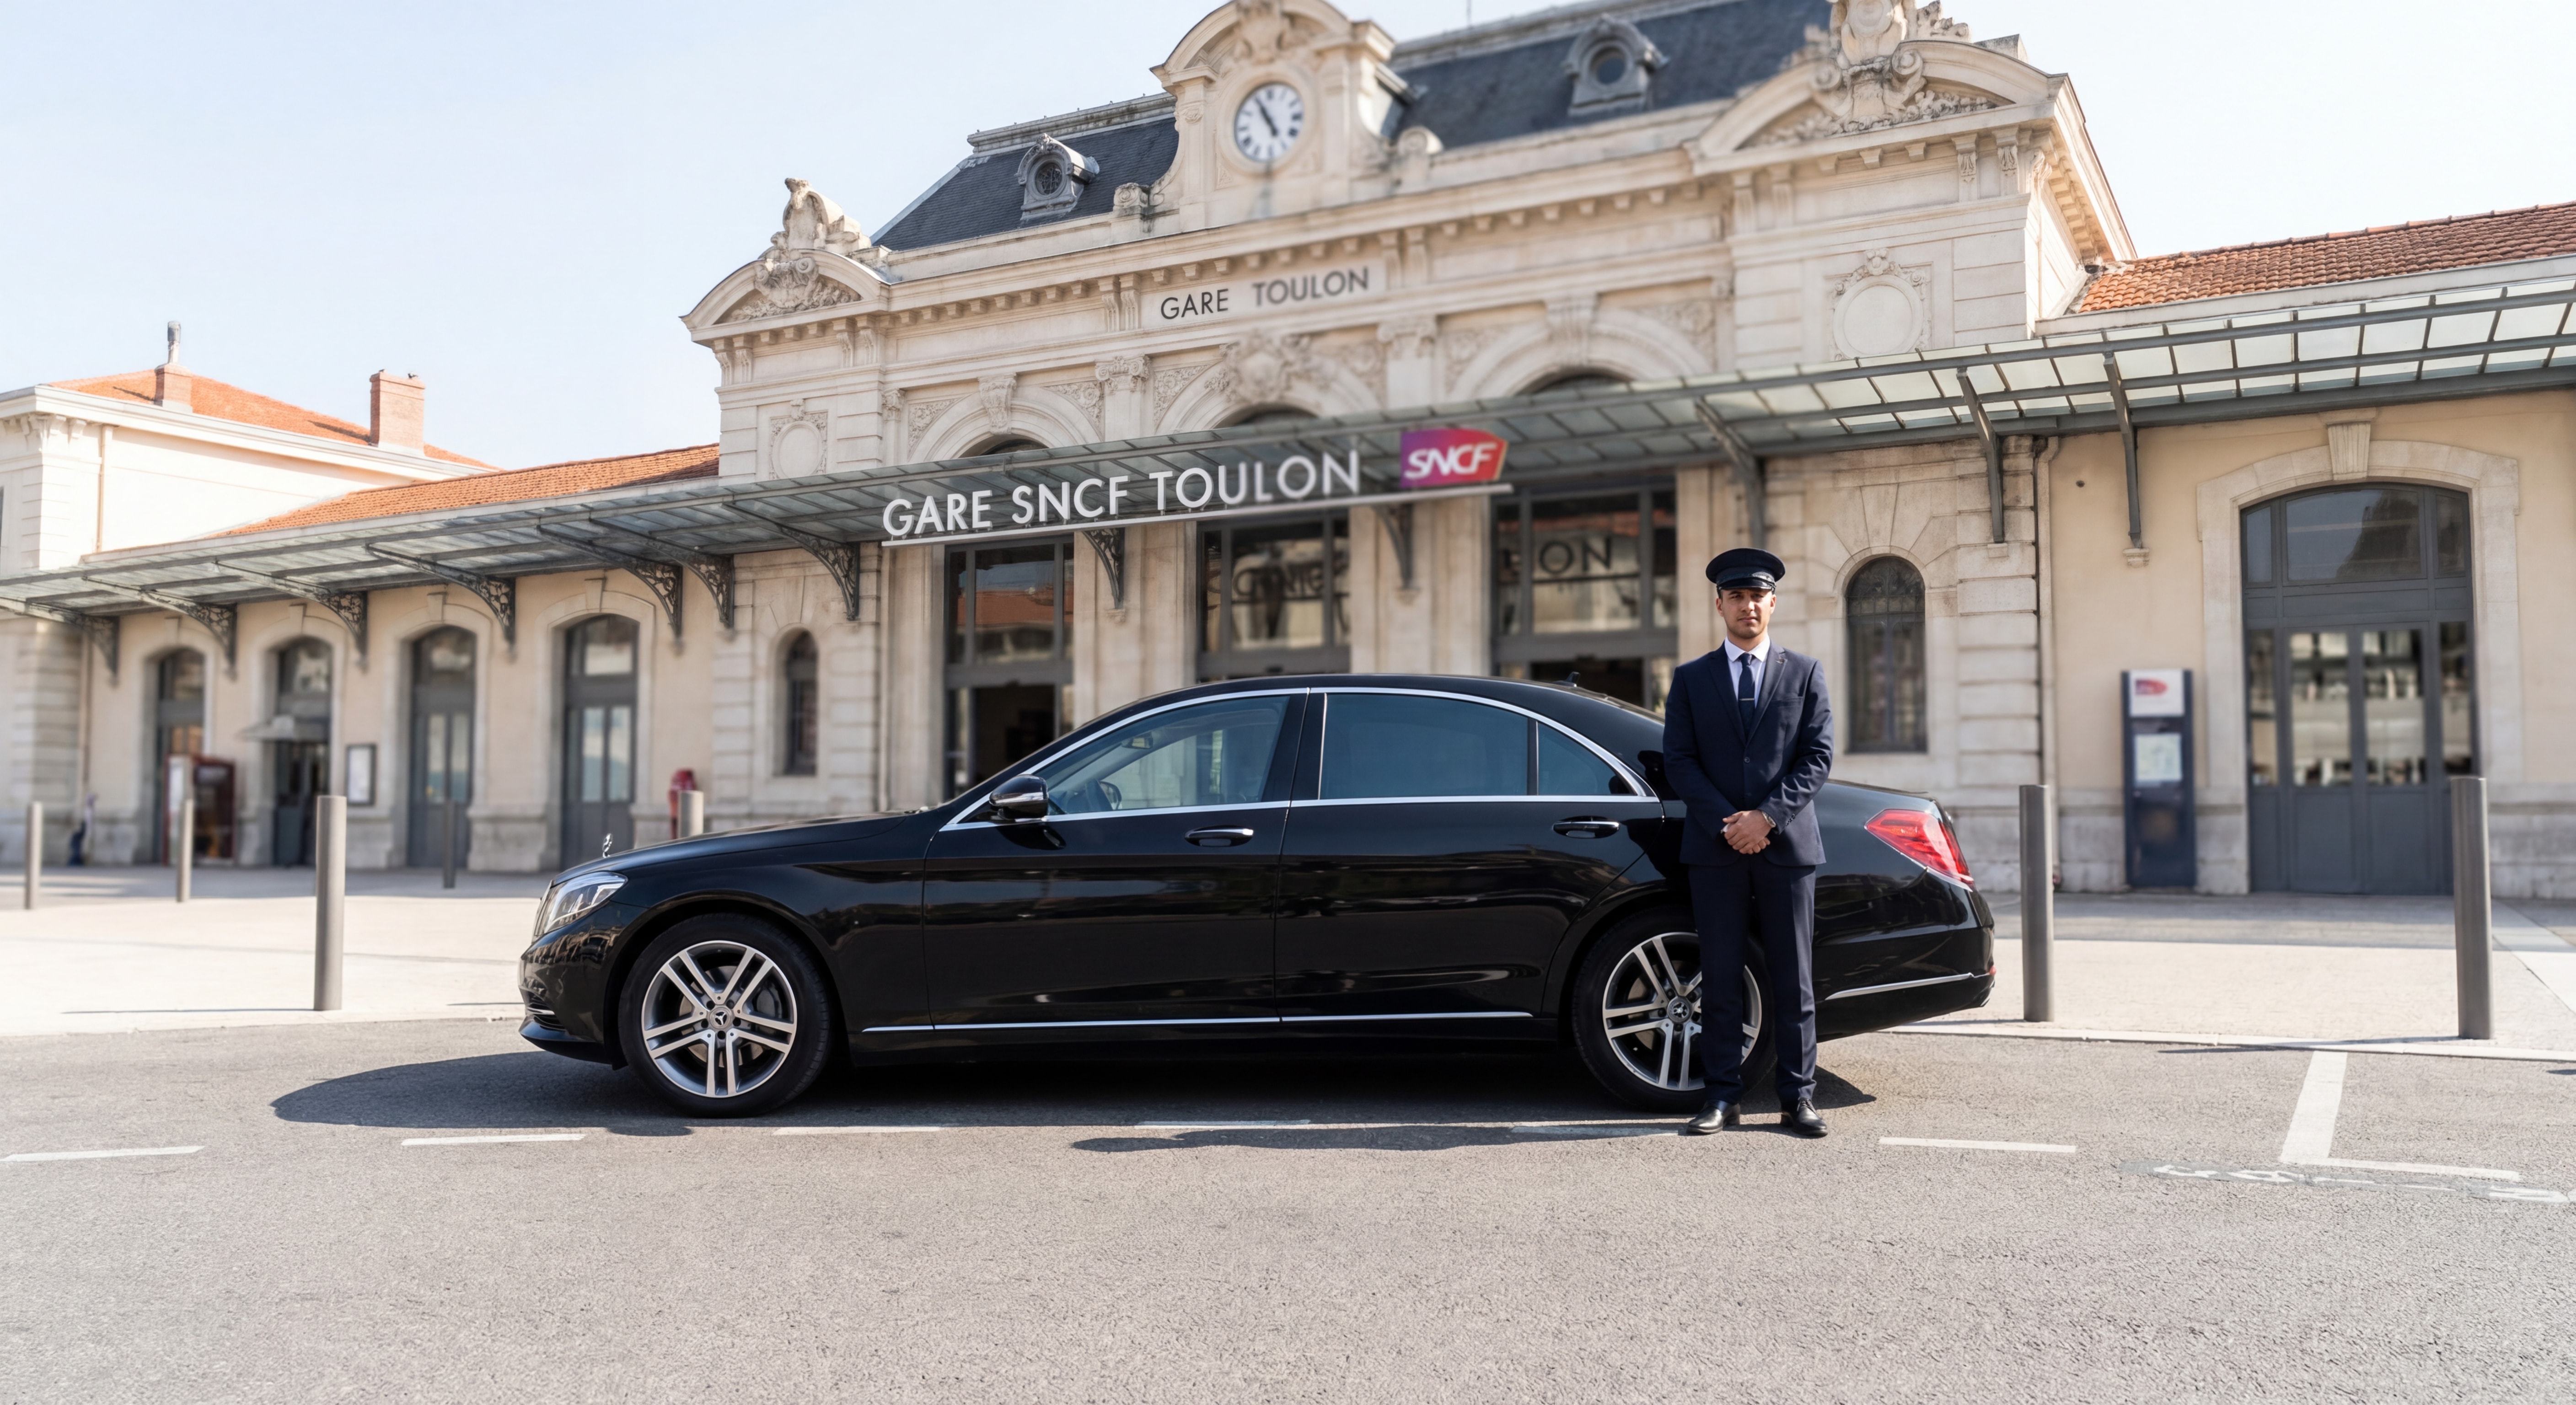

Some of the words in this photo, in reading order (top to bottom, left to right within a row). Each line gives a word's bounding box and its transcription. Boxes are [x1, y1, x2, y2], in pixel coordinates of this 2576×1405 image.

[1160, 289, 1229, 320] GARE
[1252, 267, 1369, 307] TOULON
[1405, 442, 1498, 479] SNCF
[883, 490, 993, 536] GARE
[1012, 475, 1130, 524] SNCF
[1149, 449, 1360, 511] TOULON
